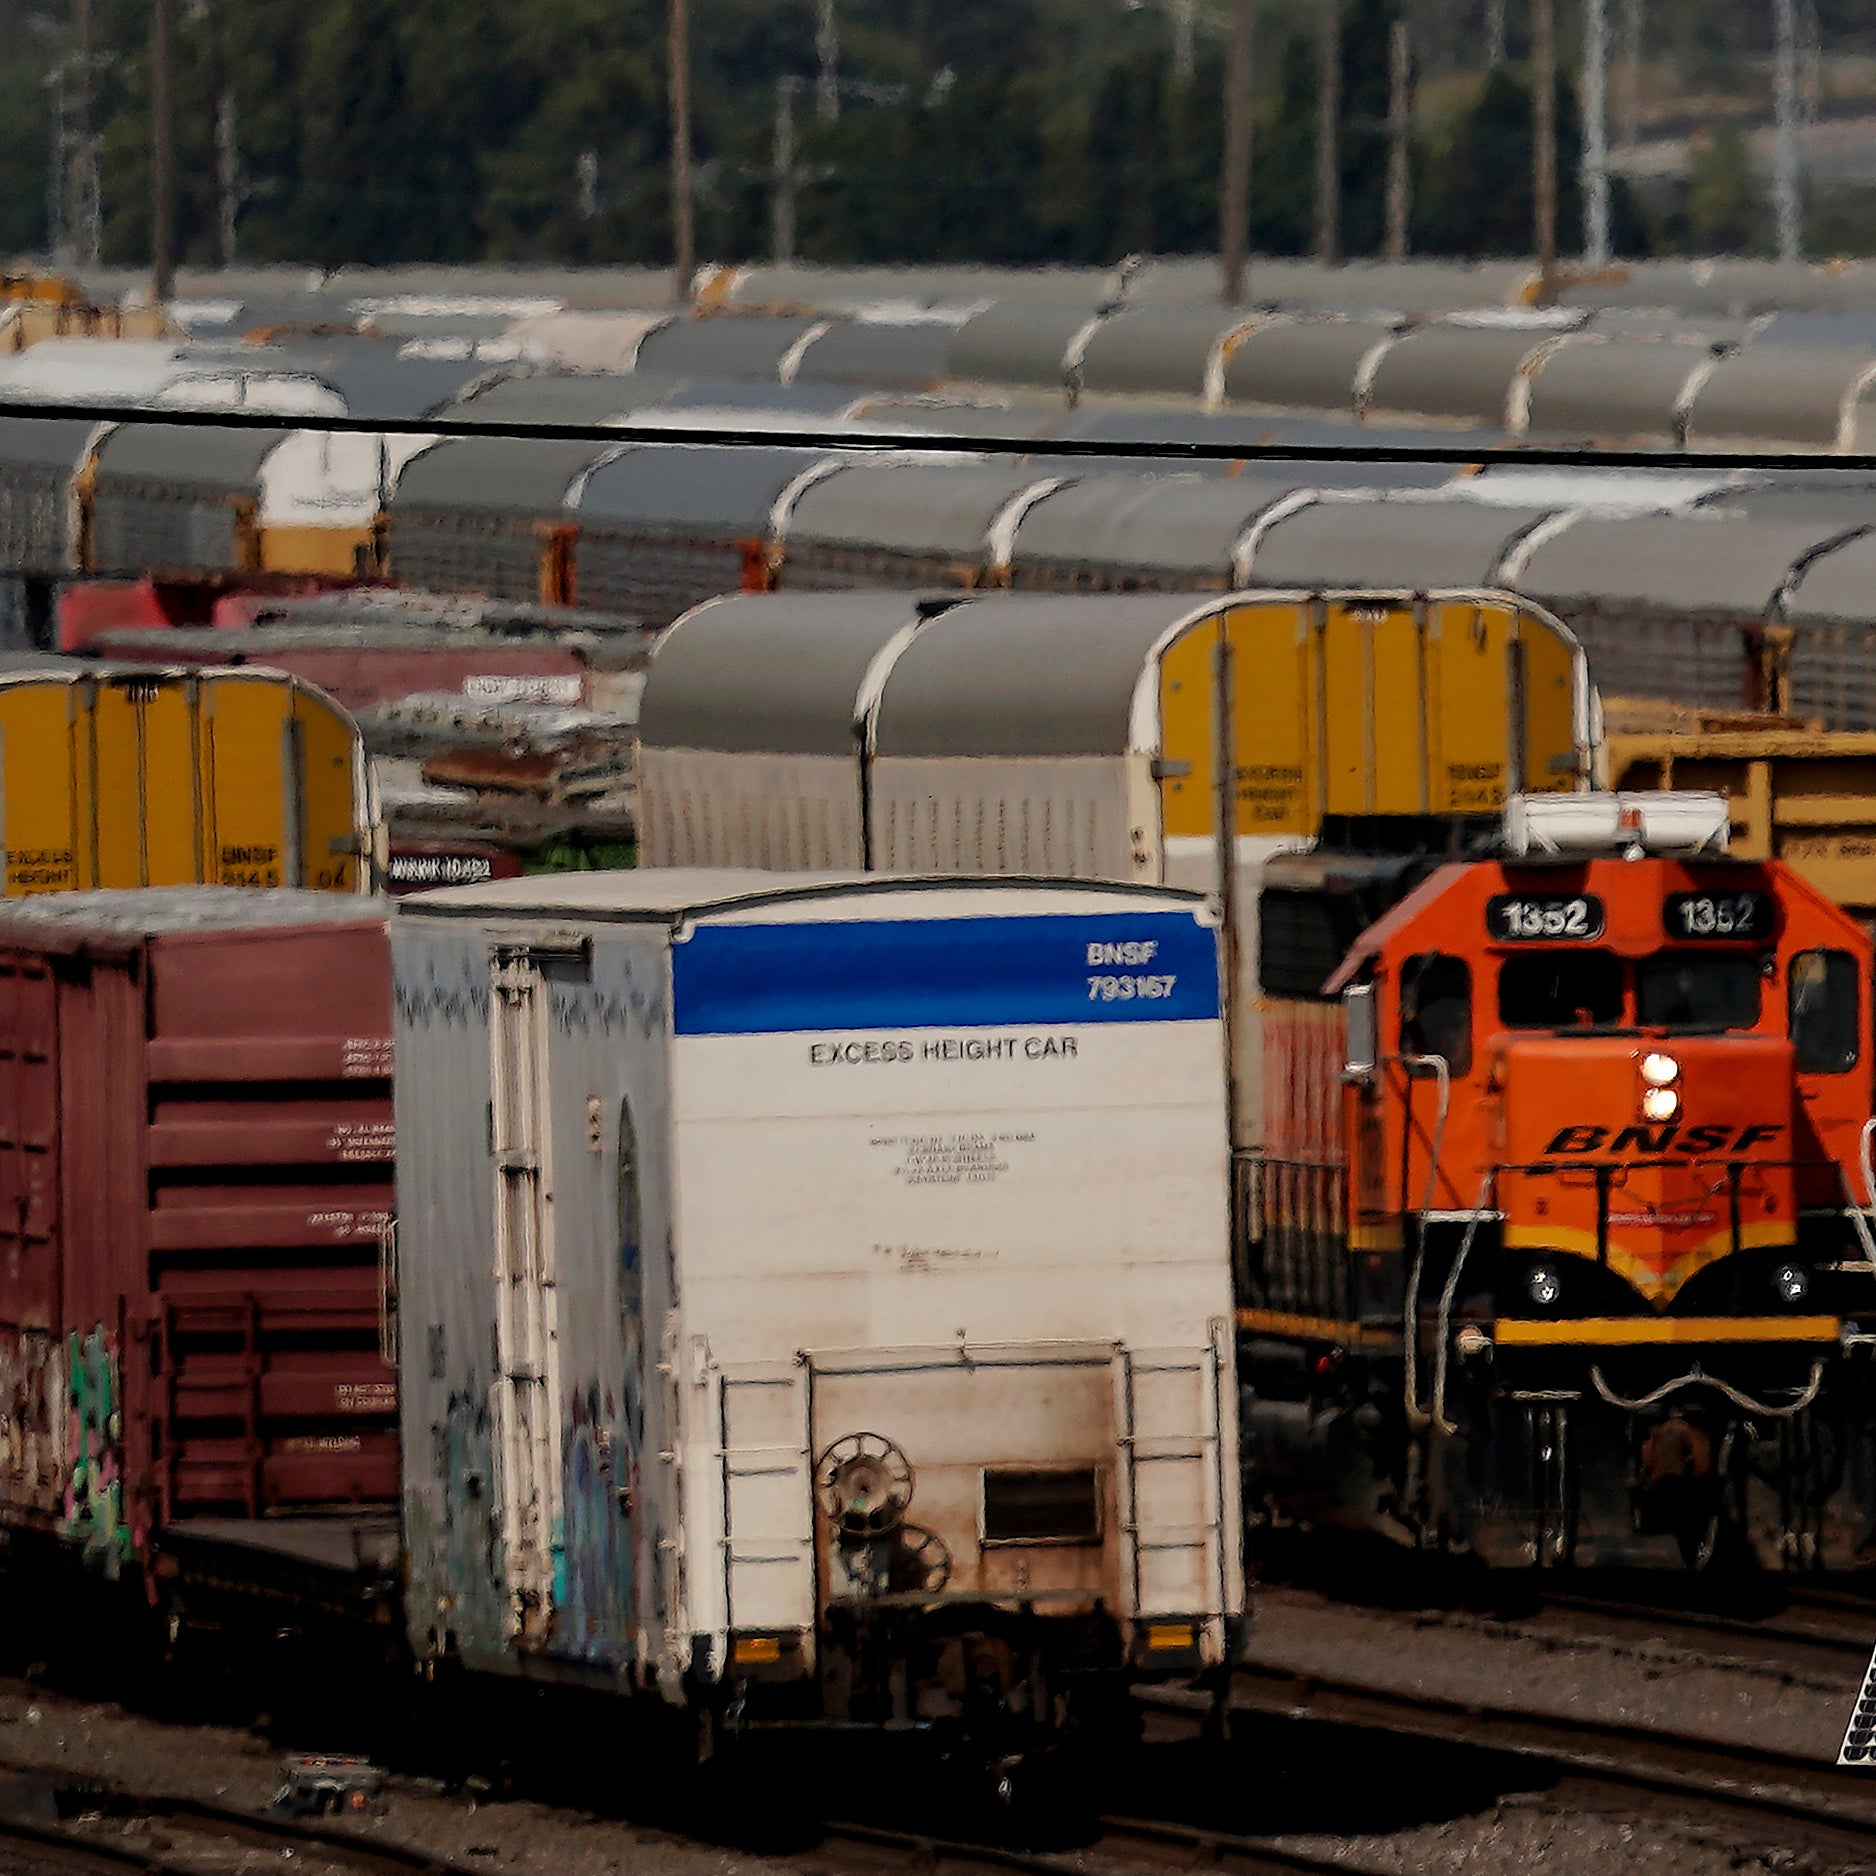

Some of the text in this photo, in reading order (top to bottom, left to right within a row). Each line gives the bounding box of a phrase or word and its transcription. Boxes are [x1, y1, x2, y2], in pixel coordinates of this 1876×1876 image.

[1501, 898, 1588, 936] 1352
[1086, 940, 1158, 966] BNSF
[811, 1036, 1079, 1065] EXCESS HEIGHT CAR
[1544, 1125, 1784, 1154] BNSF
